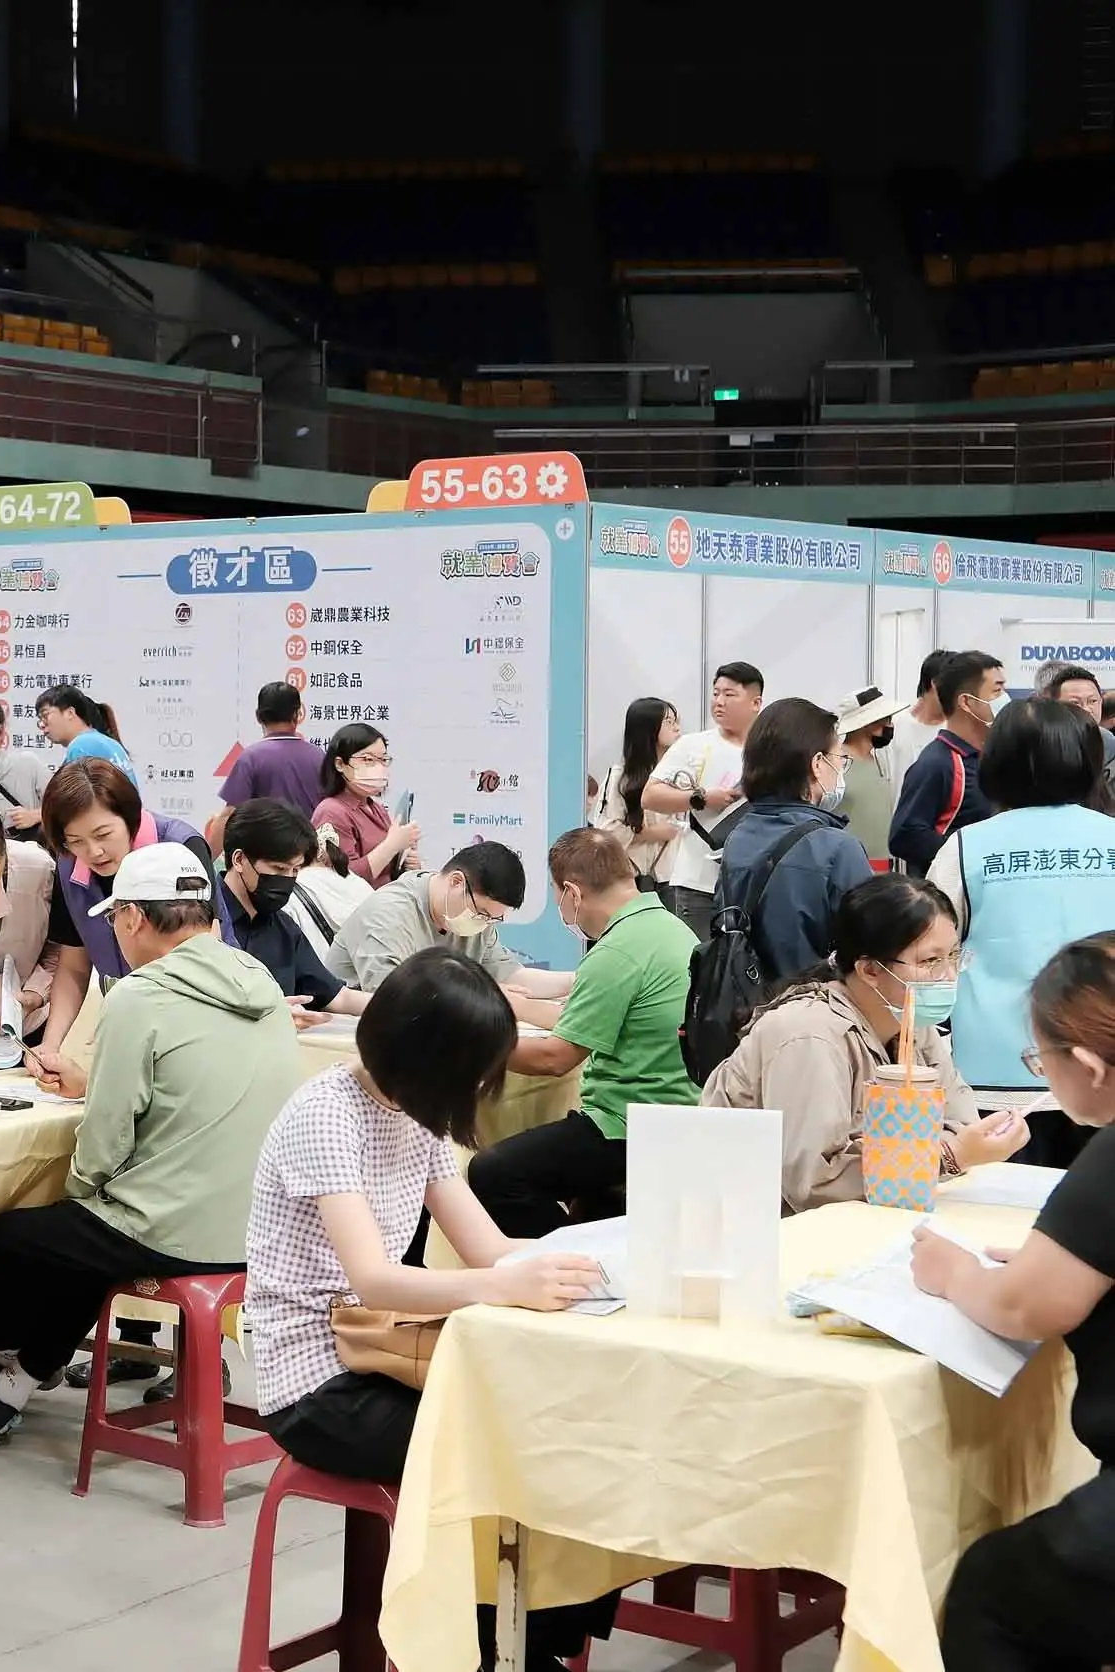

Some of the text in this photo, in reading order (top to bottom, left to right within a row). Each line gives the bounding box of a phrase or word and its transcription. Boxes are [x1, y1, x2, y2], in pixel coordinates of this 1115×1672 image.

[421, 465, 527, 503] 55-63
[0, 491, 81, 524] 64-72
[669, 528, 861, 570] 55 地天泰實業股份有限公司
[189, 549, 293, 589] 徵才區
[935, 552, 950, 572] 56
[955, 552, 1083, 585] 倫飛電腦實業股份有限公司
[14, 613, 70, 629] 力金咖啡行
[287, 609, 305, 624] 63
[287, 640, 363, 656] 62 中鋼保全
[310, 673, 363, 688] 如記食品
[310, 705, 389, 721] 海景世界企業
[469, 814, 523, 827] FamilyMart
